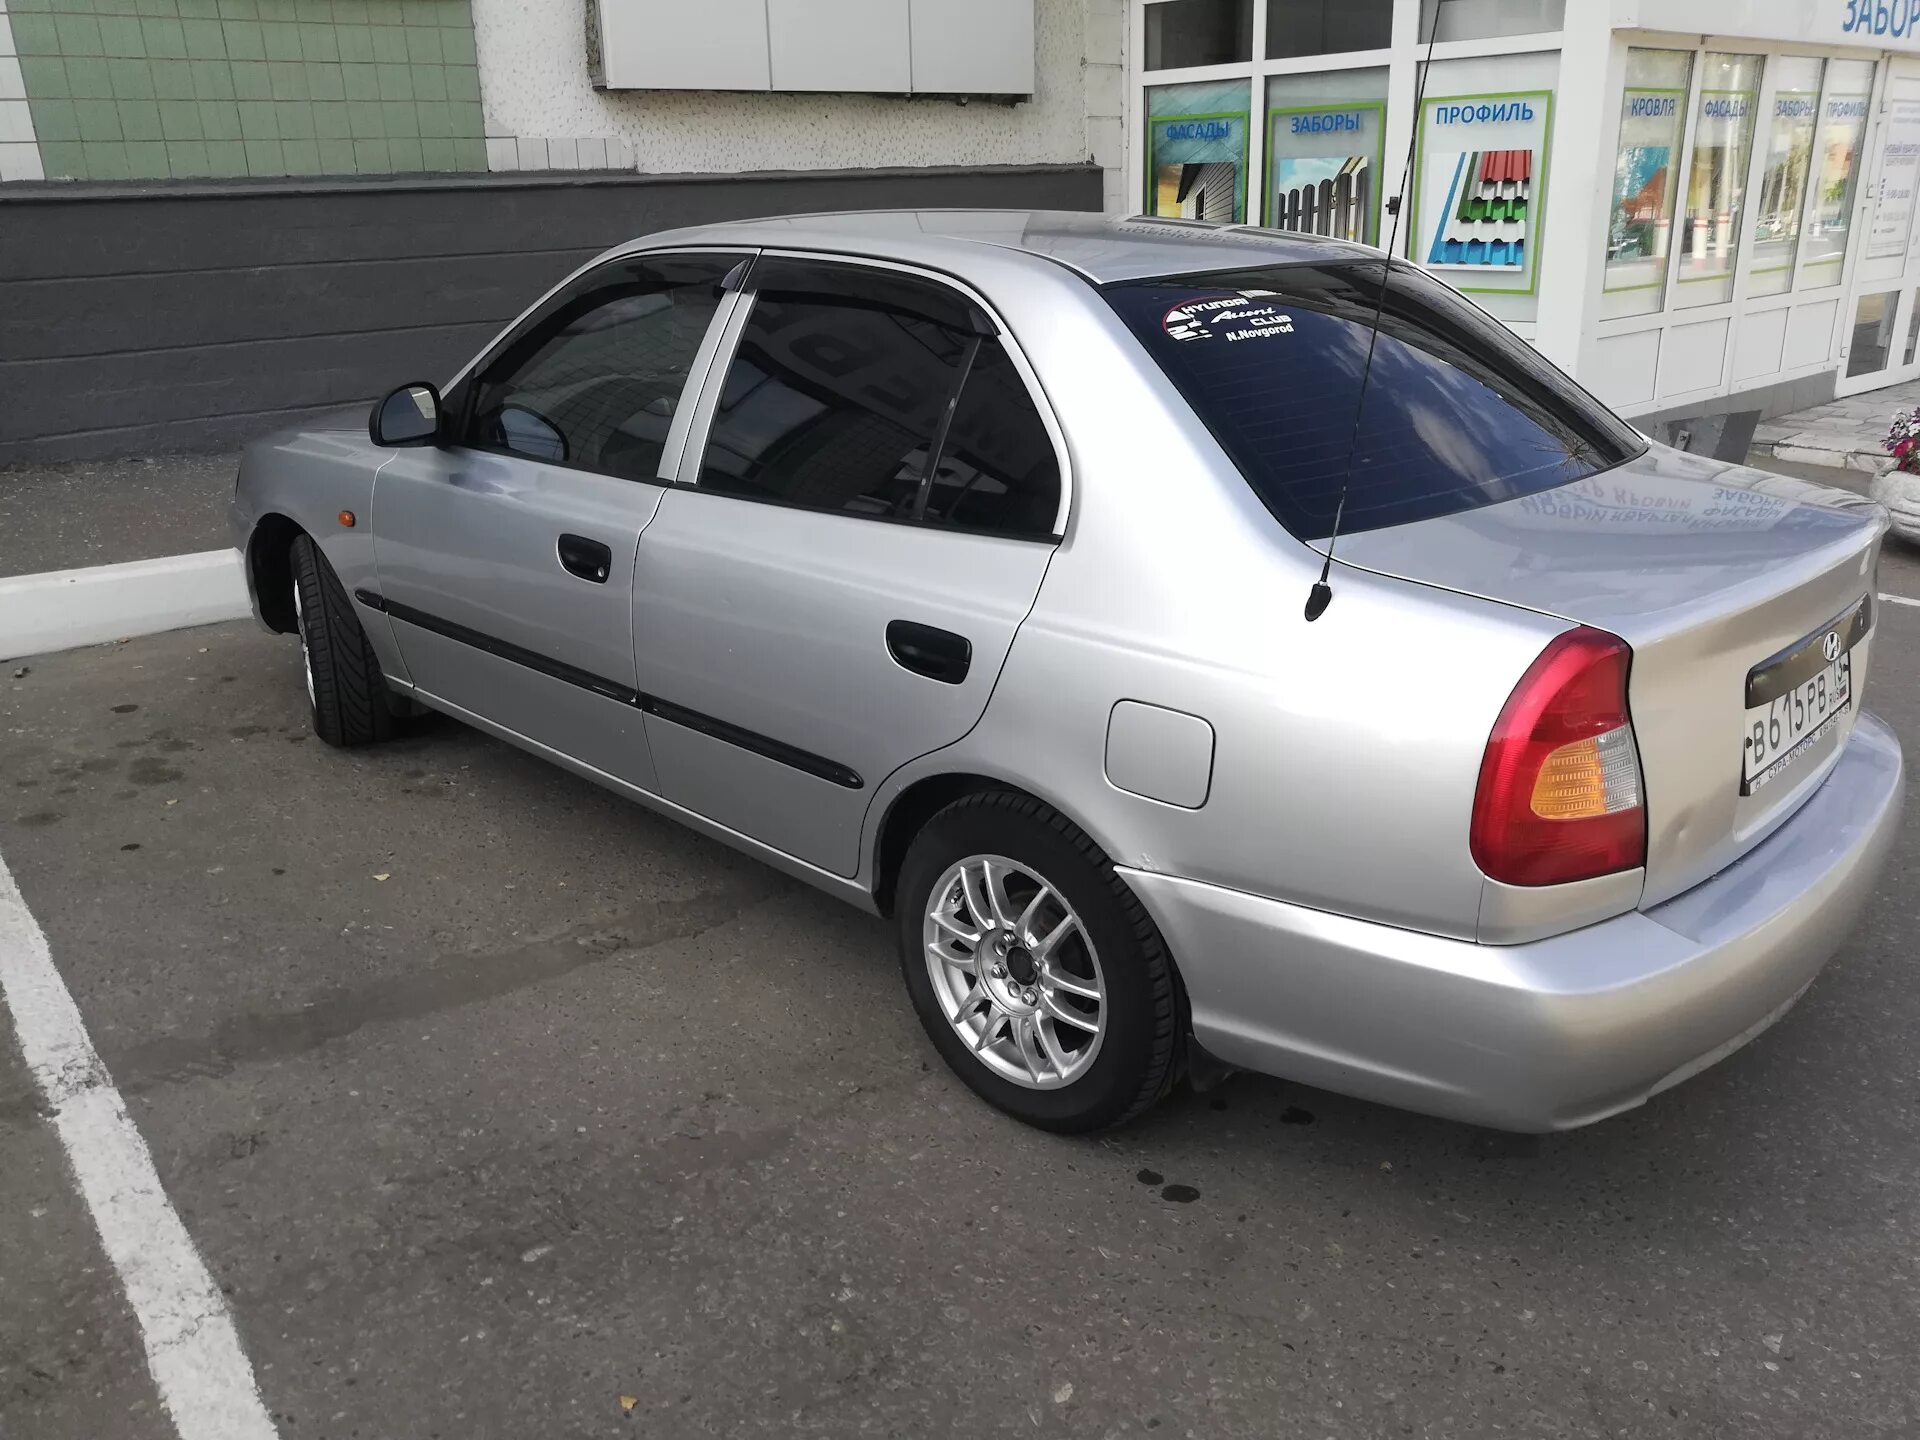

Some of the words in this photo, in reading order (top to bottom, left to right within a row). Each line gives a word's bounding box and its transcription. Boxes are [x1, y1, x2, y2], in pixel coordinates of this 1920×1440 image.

[1436, 102, 1533, 125] ПРОФИЛЬ
[1631, 98, 1675, 117] КРОВЛЯ
[1704, 100, 1747, 121] ФАСАДЫ
[1776, 100, 1814, 117] ЗАБОРЫ
[1826, 101, 1868, 118] ПРОФИЛЬ
[1166, 120, 1231, 142] ФАСАДЫ
[1291, 112, 1360, 134] ЗАБОРЫ
[1181, 298, 1249, 314] HYUNDAI
[1250, 315, 1292, 326] CLUB
[1226, 323, 1294, 342] N.Novgorod
[1768, 732, 1816, 779] СУРА-МОТОРС
